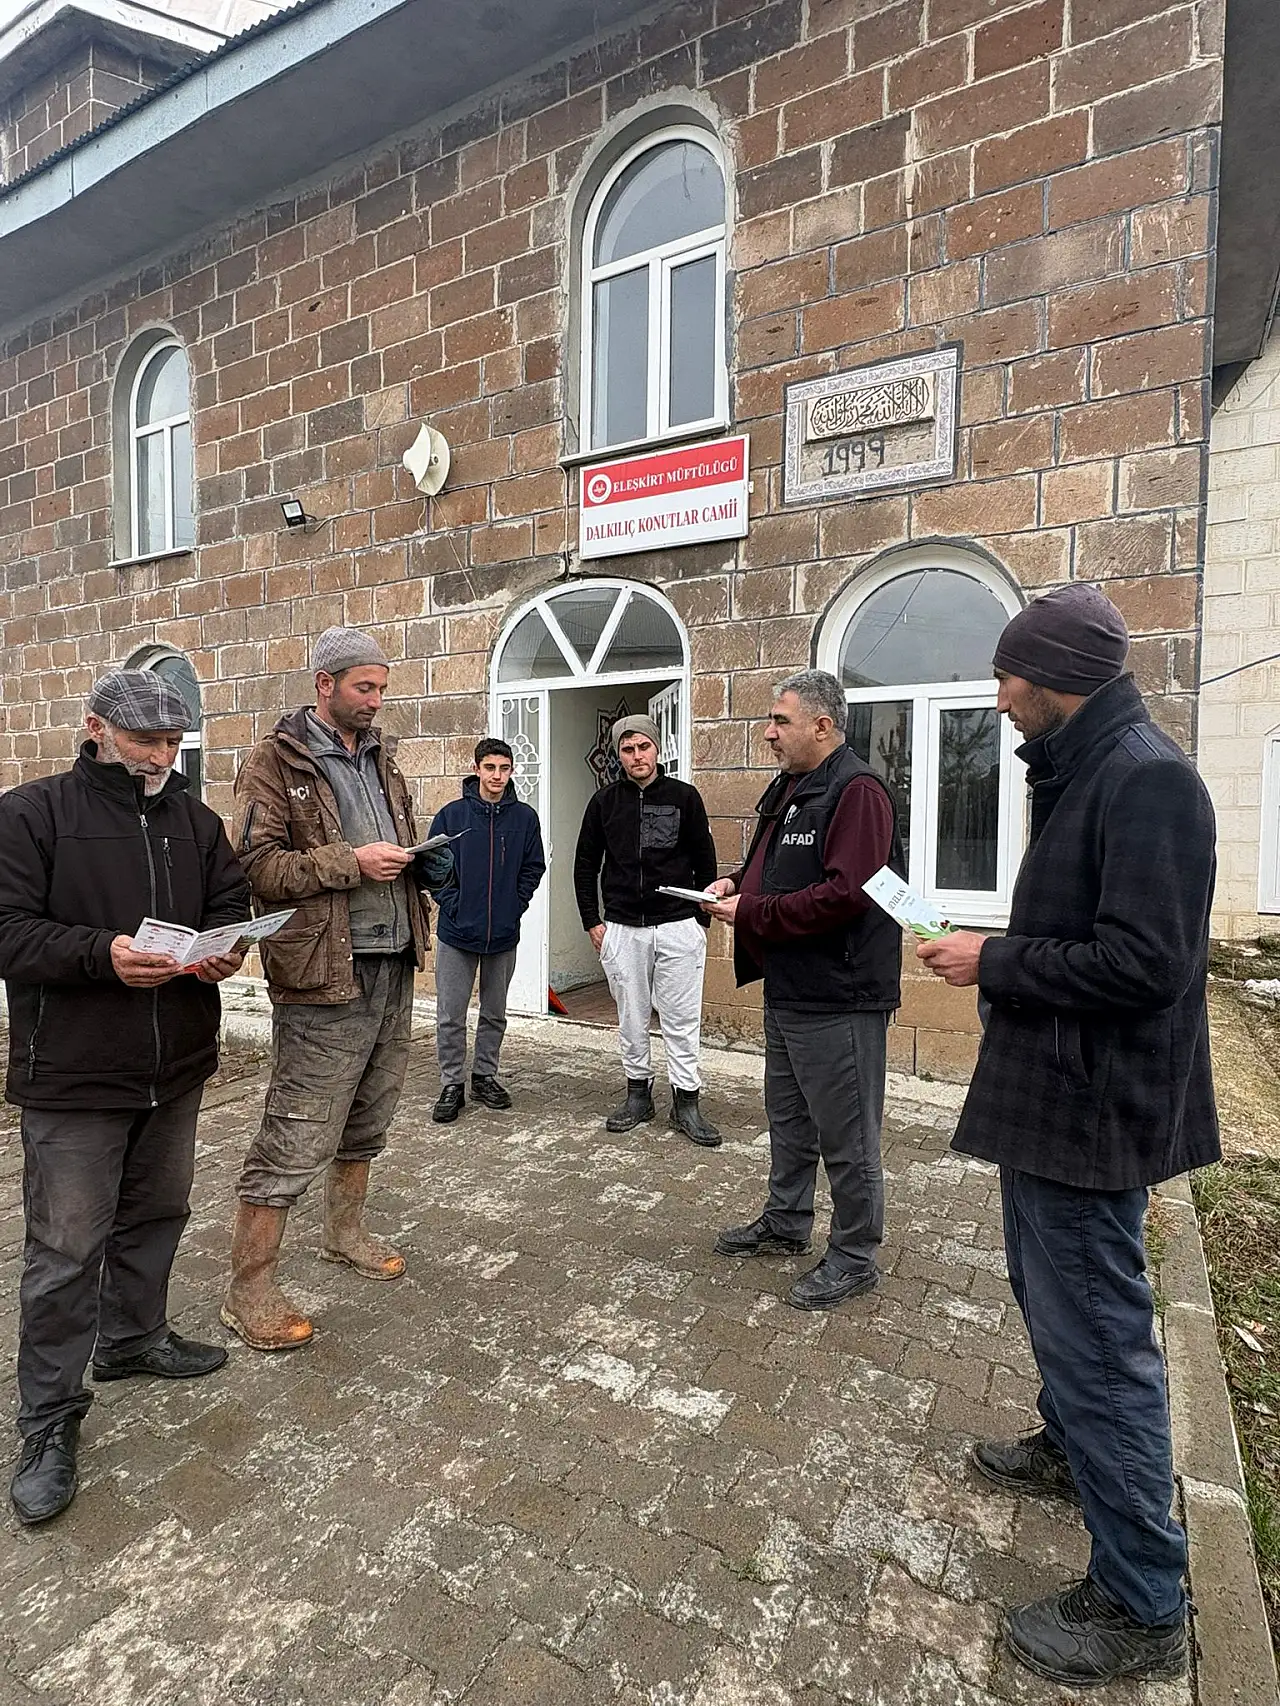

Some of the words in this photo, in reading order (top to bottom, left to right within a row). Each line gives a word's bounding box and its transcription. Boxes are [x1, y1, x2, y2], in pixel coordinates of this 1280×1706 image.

[822, 430, 885, 476] 1999
[613, 472, 665, 493] ELEŞKİRT
[586, 519, 635, 541] DALKILIÇ
[638, 509, 698, 533] KONUTLAR
[702, 497, 738, 523] CAMİİ
[781, 832, 814, 846] AFAD
